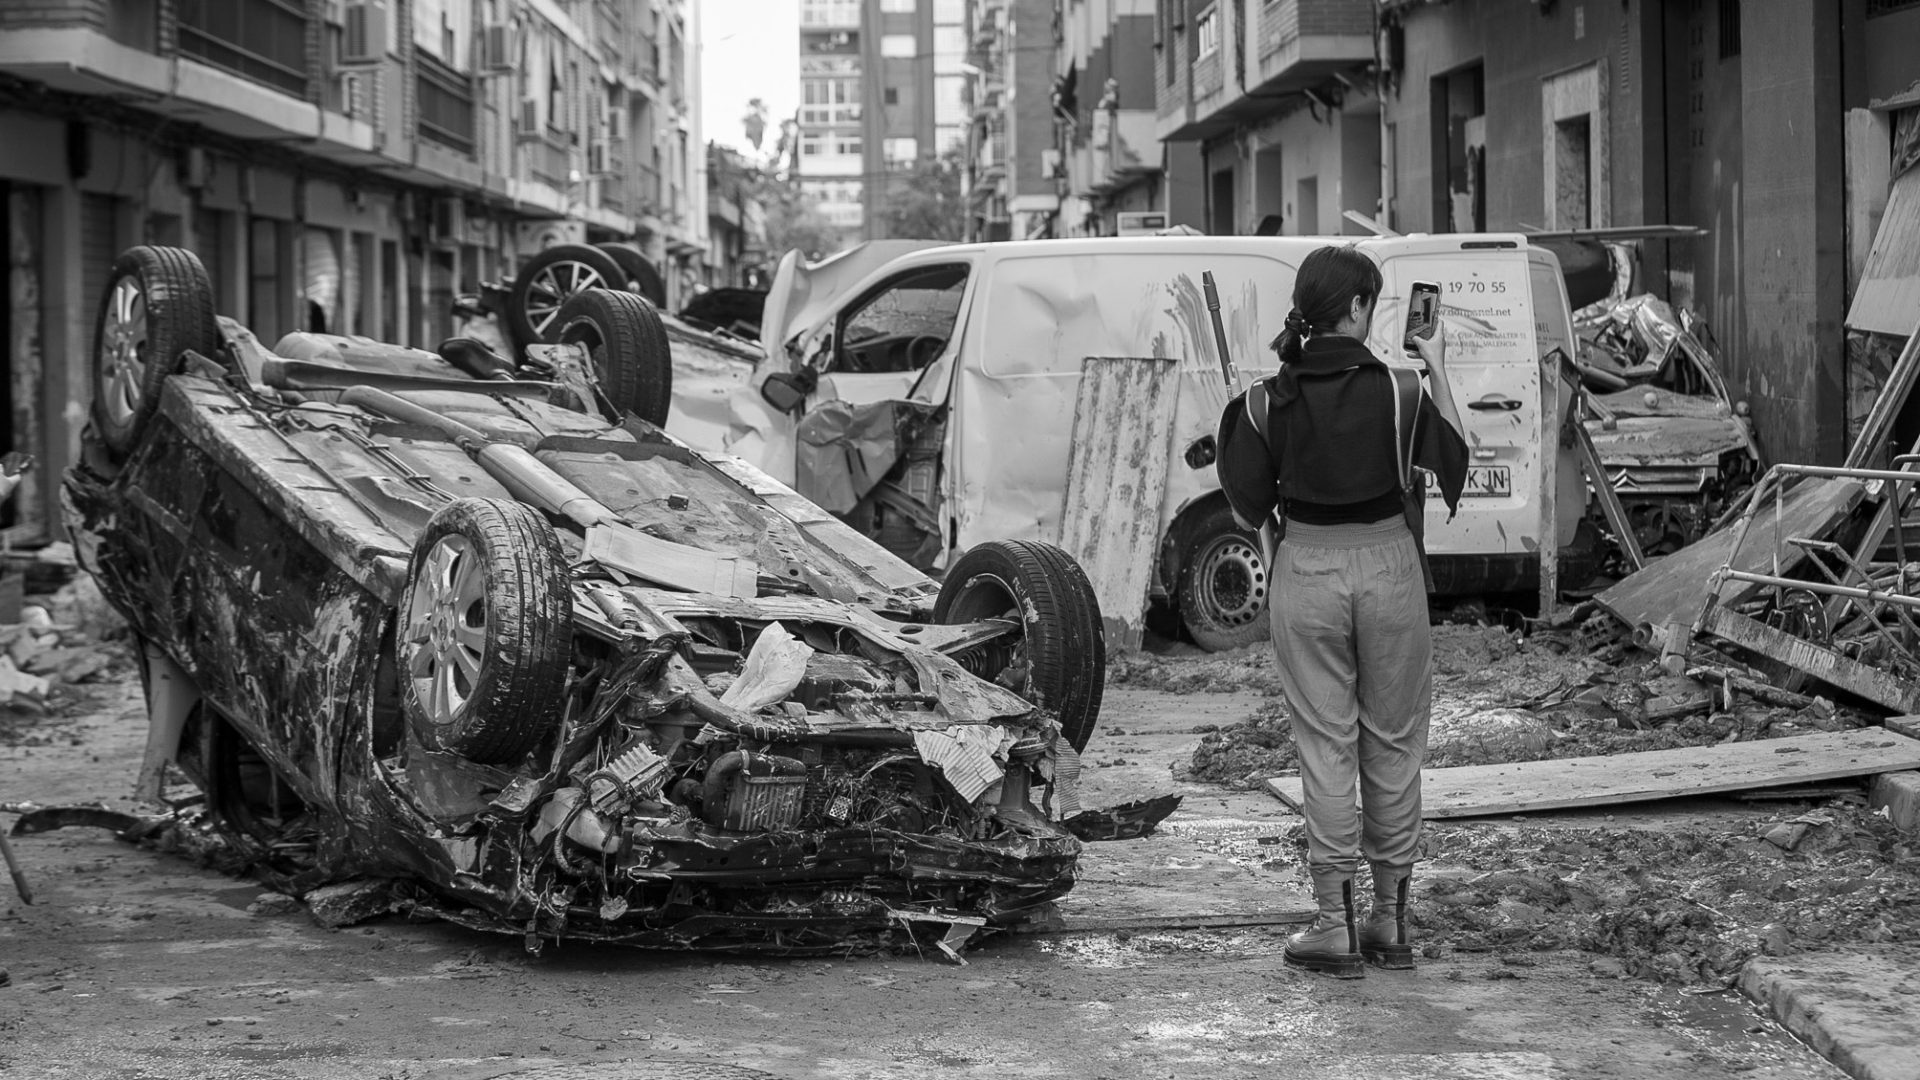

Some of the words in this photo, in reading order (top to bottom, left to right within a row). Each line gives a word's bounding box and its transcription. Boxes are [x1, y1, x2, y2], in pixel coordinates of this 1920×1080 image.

[1449, 281, 1463, 293] 19
[1468, 281, 1485, 293] 70
[1491, 281, 1506, 293] 55
[1468, 470, 1505, 489] KJN
